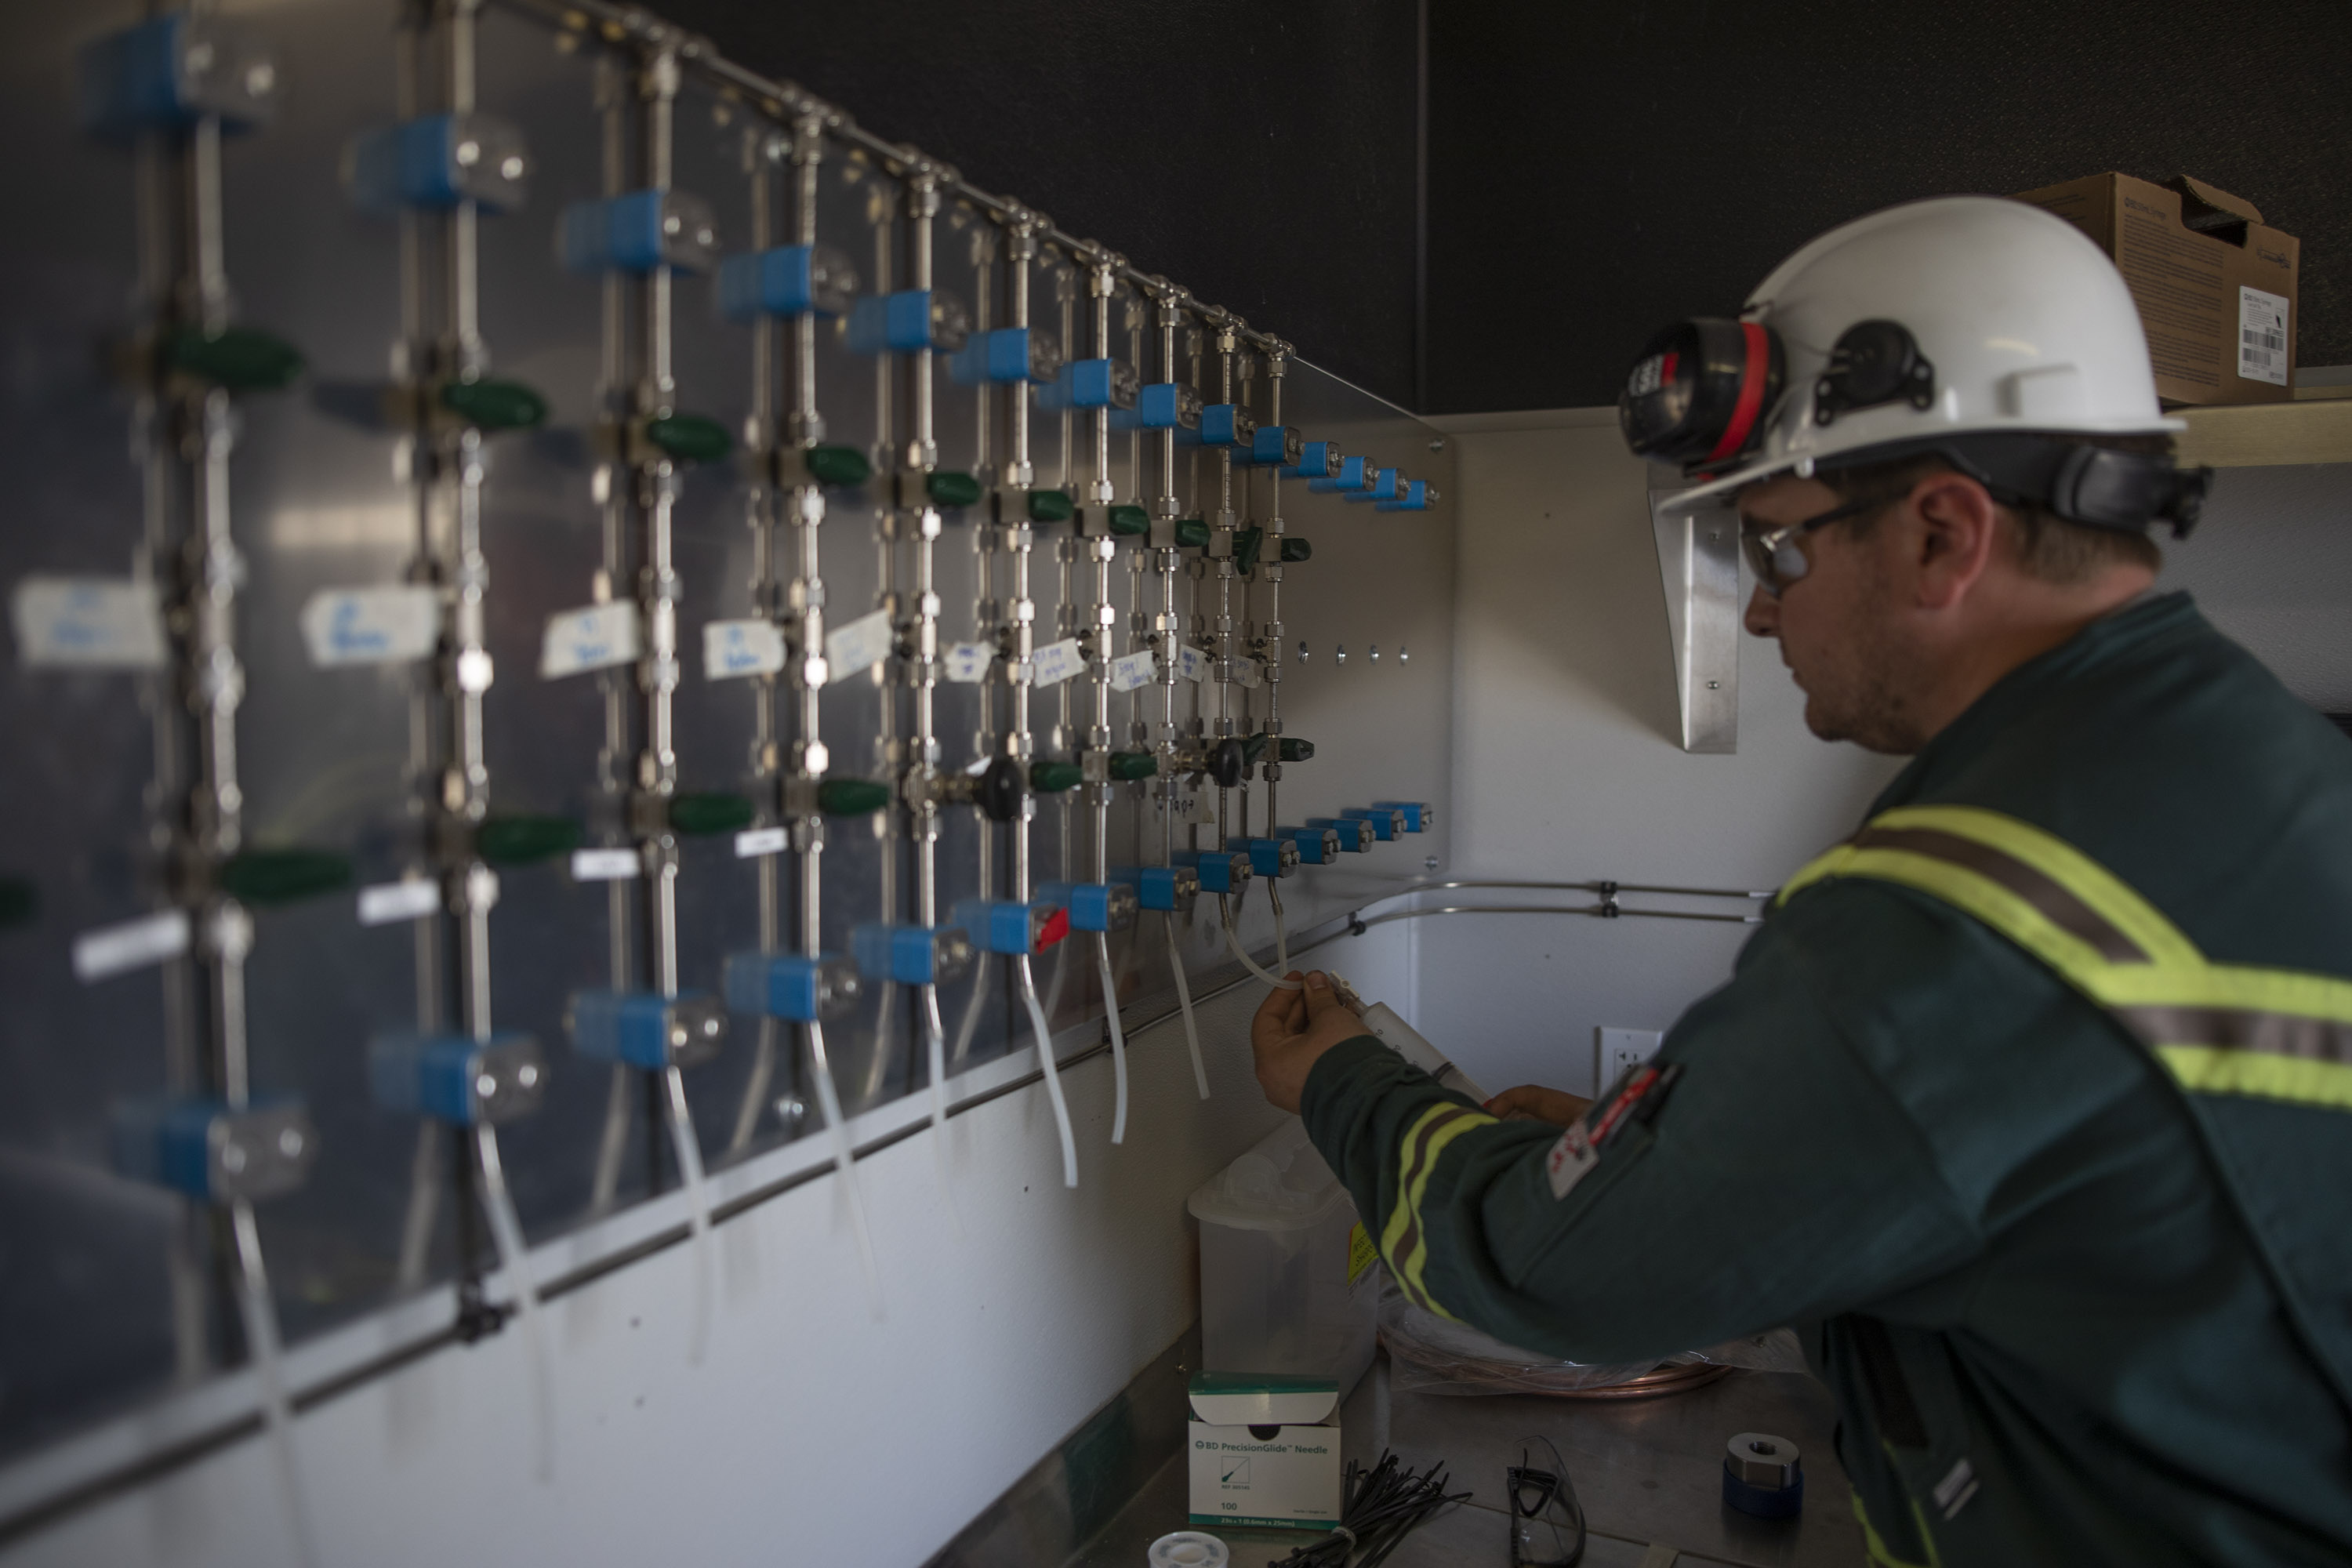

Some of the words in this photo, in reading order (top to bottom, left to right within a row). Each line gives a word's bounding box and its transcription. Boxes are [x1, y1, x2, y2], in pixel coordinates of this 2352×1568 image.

[1206, 1442, 1218, 1450] BD
[1295, 1446, 1328, 1454] Needle
[1221, 1502, 1237, 1511] 100
